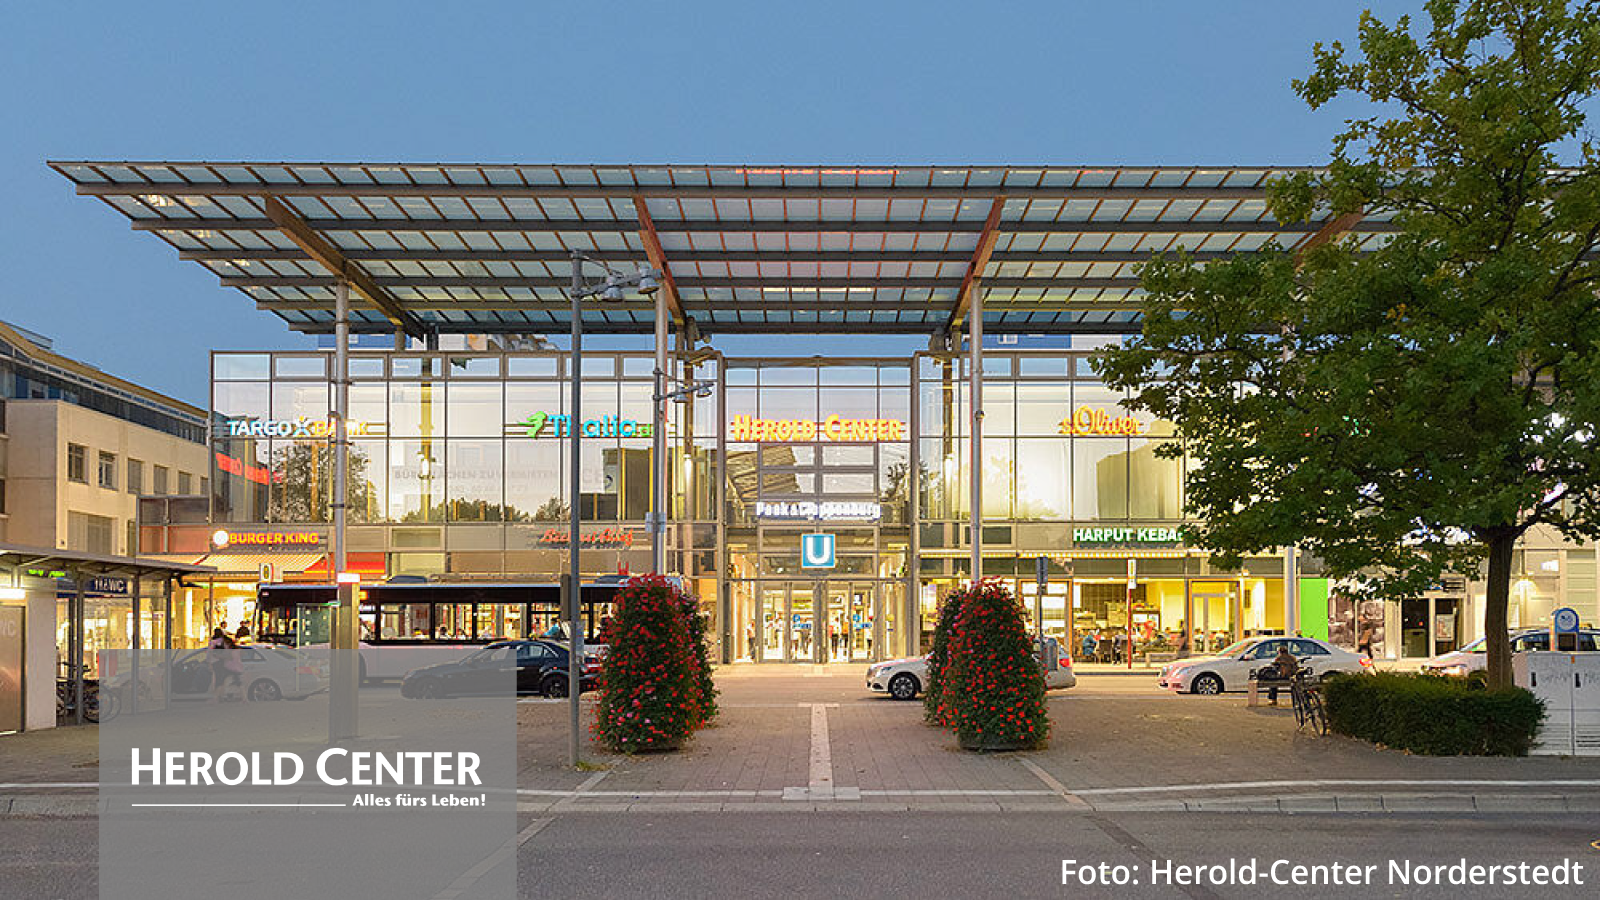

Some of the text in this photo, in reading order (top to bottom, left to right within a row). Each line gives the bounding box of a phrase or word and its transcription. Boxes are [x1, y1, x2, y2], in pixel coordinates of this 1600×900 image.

[734, 414, 902, 441] HEROLD CENTER
[229, 532, 319, 544] BURGER KING
[1073, 527, 1183, 542] HARPUT KEBA
[806, 536, 831, 565] U
